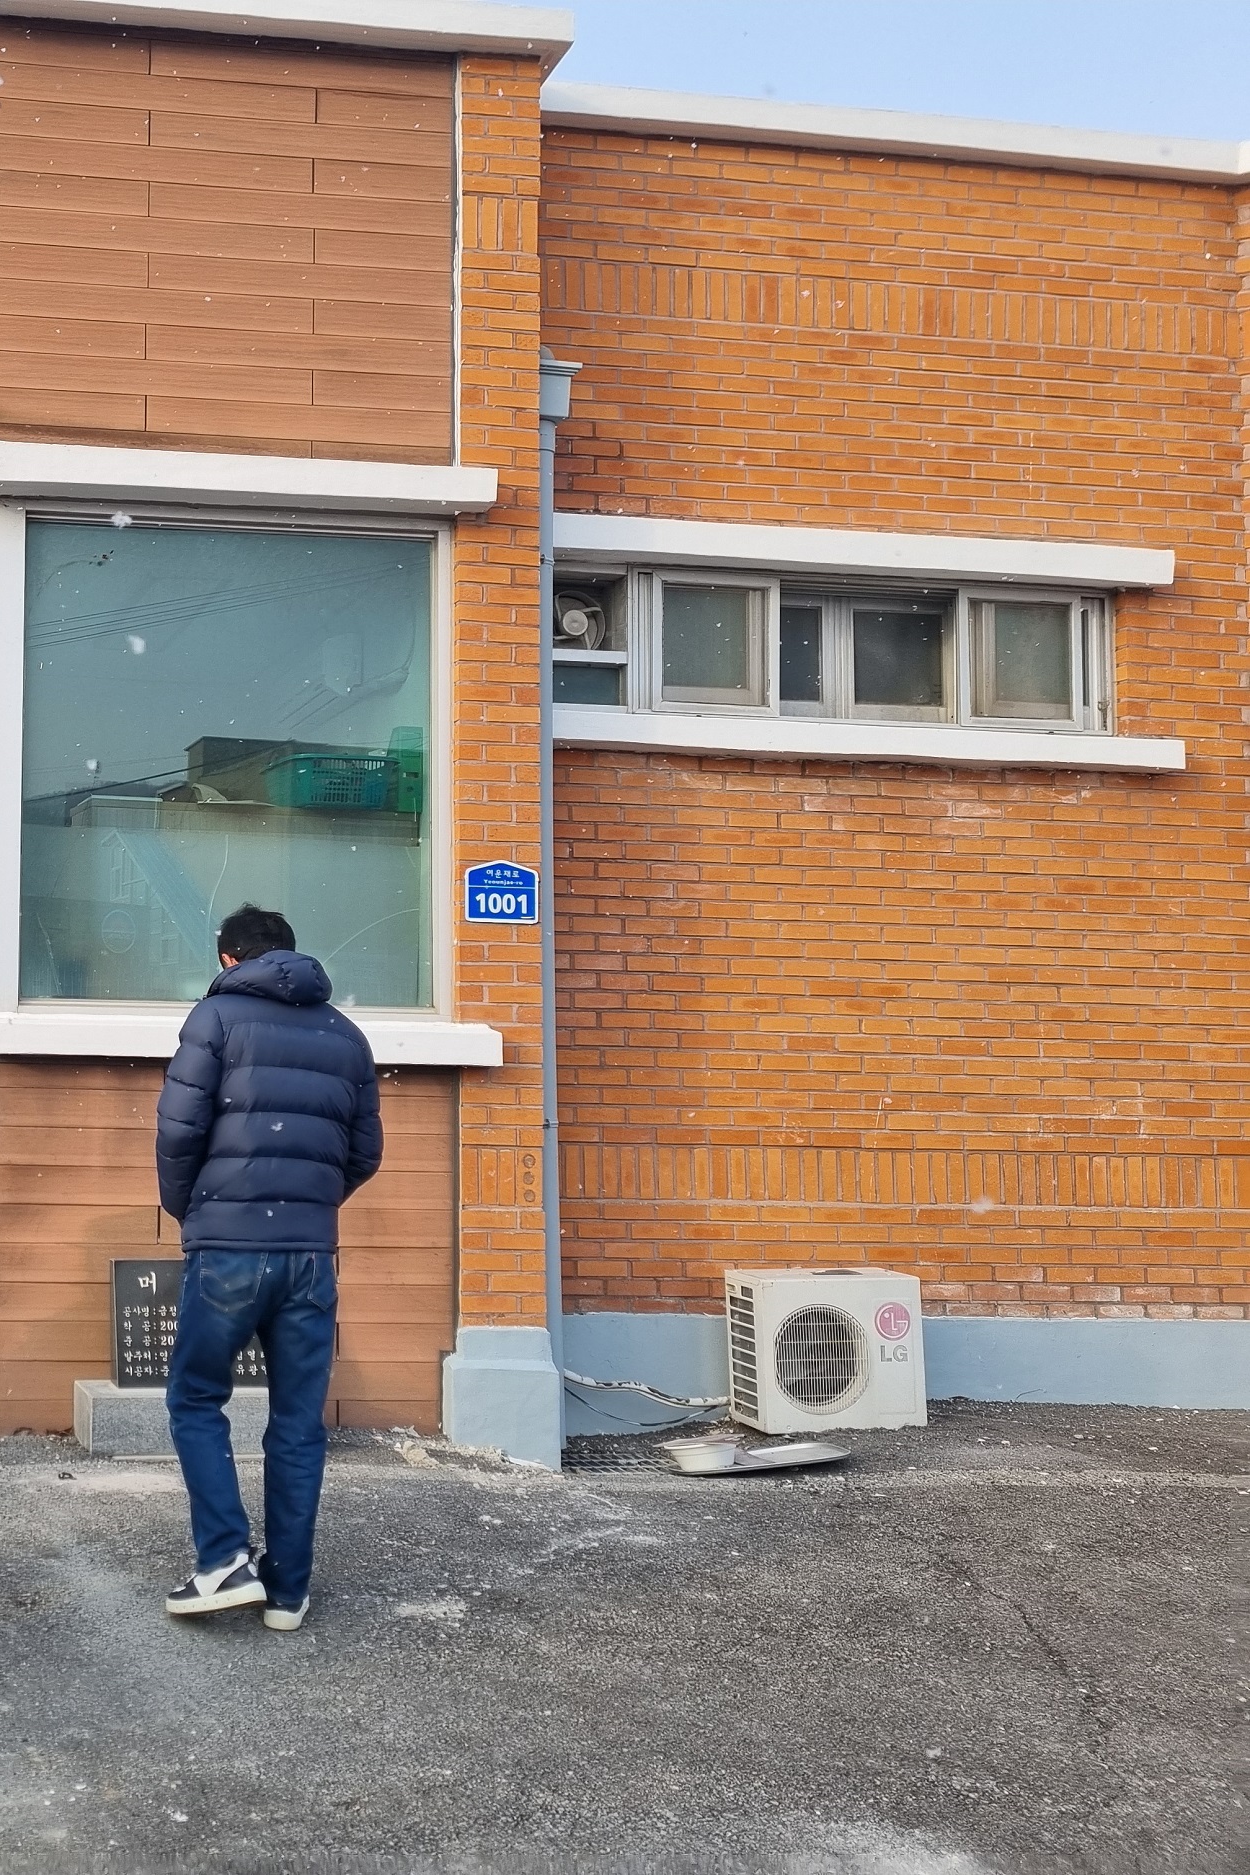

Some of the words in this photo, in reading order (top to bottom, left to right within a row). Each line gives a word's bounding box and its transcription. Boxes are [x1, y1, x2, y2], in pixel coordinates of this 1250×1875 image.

[486, 869, 520, 879] 여운재로
[475, 893, 528, 914] 1001
[138, 1271, 157, 1295] 머
[880, 1344, 908, 1362] LG
